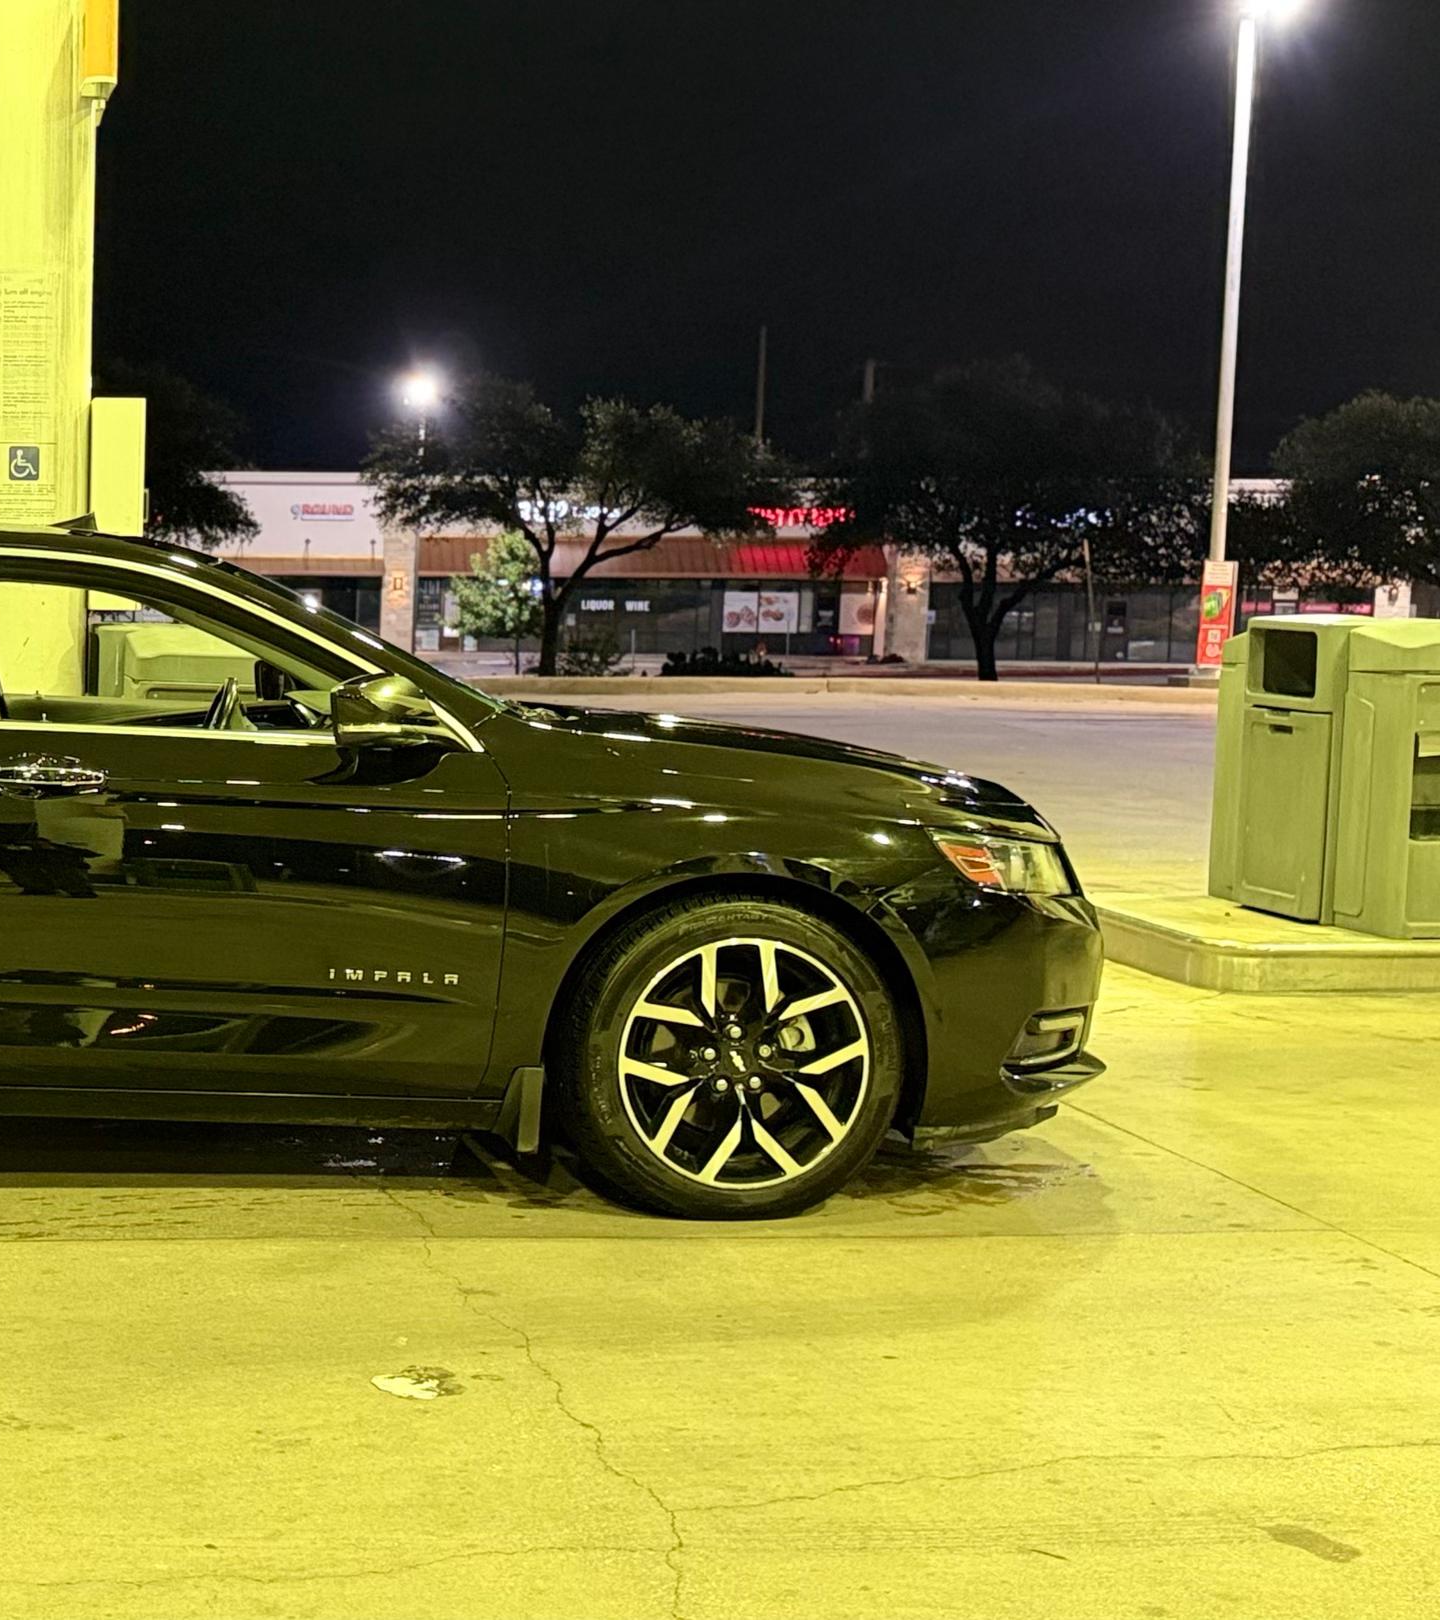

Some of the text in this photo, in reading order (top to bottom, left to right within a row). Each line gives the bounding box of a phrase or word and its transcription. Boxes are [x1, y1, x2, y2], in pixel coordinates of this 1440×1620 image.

[581, 599, 651, 612] LIQUOR WINE
[329, 968, 459, 985] IMPALA
